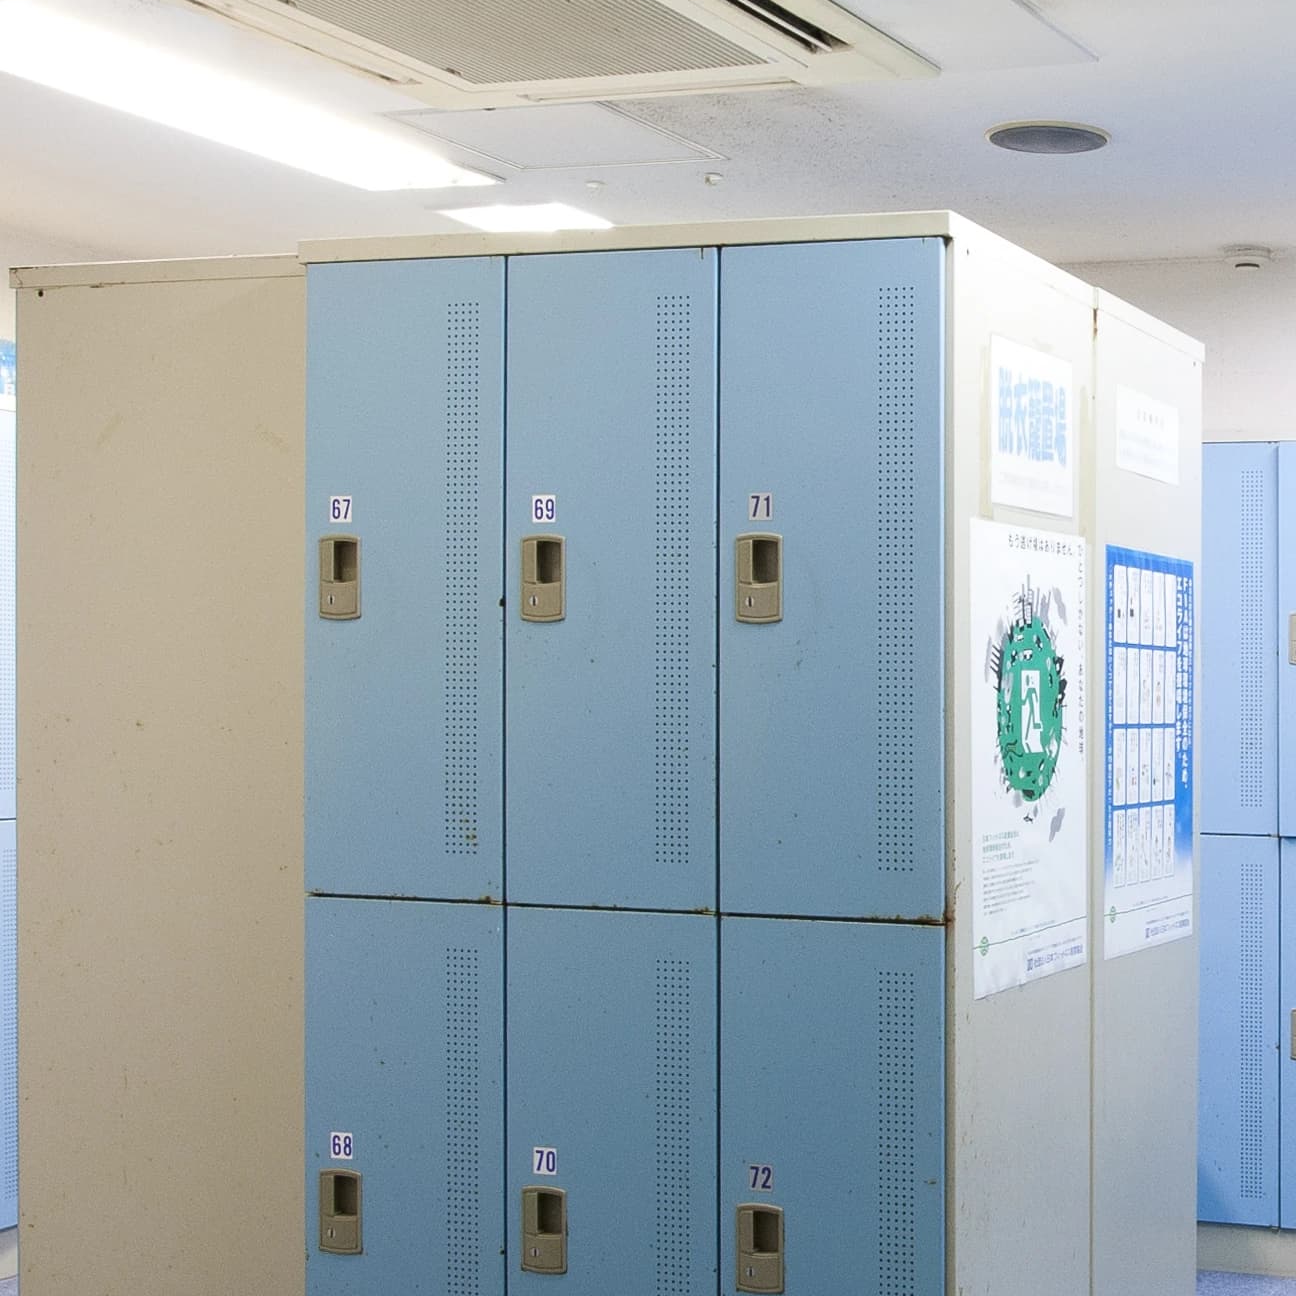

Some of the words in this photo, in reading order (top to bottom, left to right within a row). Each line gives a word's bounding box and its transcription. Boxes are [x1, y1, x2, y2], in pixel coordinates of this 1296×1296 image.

[332, 498, 351, 520] 67
[534, 498, 556, 521] 69
[751, 495, 771, 518] 71
[332, 1134, 353, 1157] 68
[535, 1150, 557, 1173] 70
[749, 1166, 772, 1189] 72
